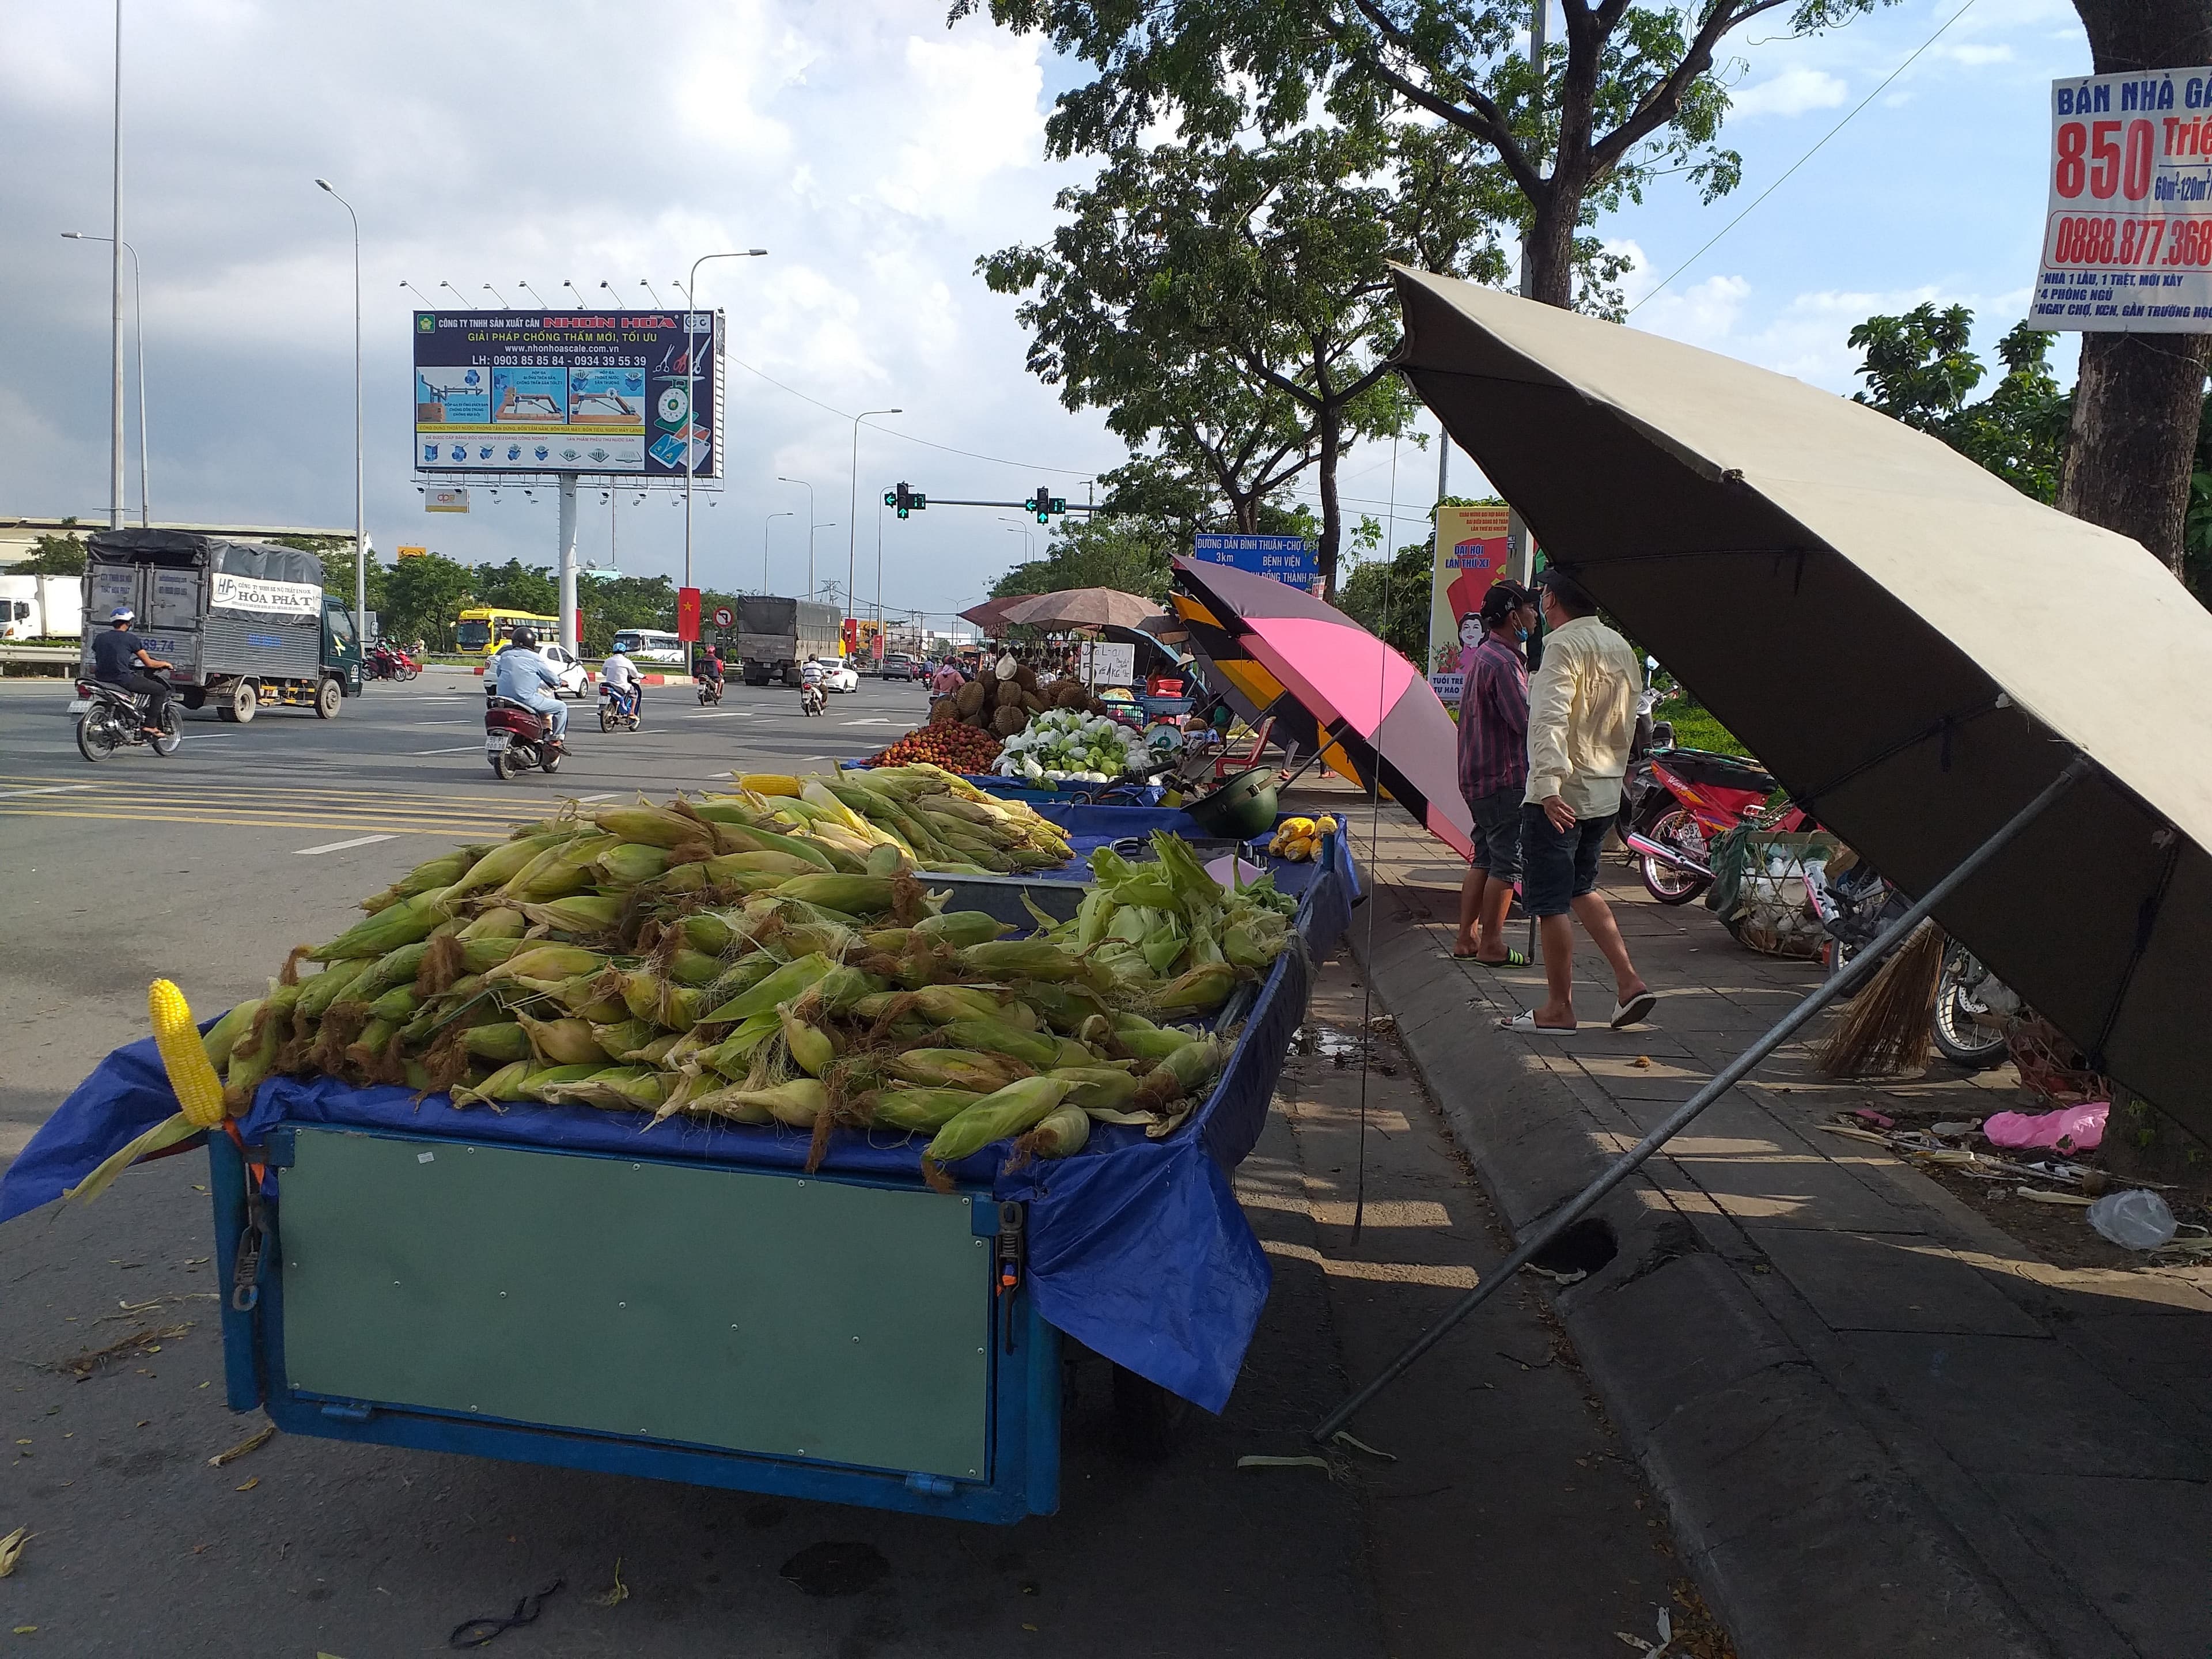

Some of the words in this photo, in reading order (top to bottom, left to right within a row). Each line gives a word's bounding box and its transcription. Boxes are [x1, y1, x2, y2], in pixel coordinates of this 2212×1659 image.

[2058, 79, 2110, 115] BÁN
[2122, 73, 2174, 111] NHÀ
[2056, 118, 2155, 200] 850
[2055, 217, 2212, 266] 0888.877.368
[2069, 273, 2074, 285] 1
[2102, 274, 2107, 285] 1
[2040, 289, 2048, 299] 4
[2050, 287, 2088, 301] PHÒNG
[2090, 287, 2113, 301] NGỦ
[438, 318, 458, 328] CÔNG
[459, 319, 468, 328] TY
[469, 319, 488, 328] TNHH
[490, 317, 504, 328] SẢN
[506, 316, 523, 328] XUẤT
[525, 317, 540, 328] CÂN
[544, 316, 615, 328] NHƠN
[468, 330, 488, 341] GIẢI
[492, 331, 520, 341] PHÁP
[523, 330, 560, 342] CHỐNG
[564, 330, 593, 342] THẤM
[597, 331, 619, 343] MỚI,
[622, 330, 639, 342] TỐI
[643, 332, 657, 342] ƯU
[505, 344, 619, 353] www.nhonhoascale.com.vn
[472, 355, 490, 365] LH:
[494, 355, 518, 365] 0903
[521, 355, 533, 365] 85
[536, 355, 549, 365] 85
[552, 355, 565, 365] 84
[574, 356, 599, 366] 0934
[602, 356, 615, 366] 39
[618, 356, 631, 366] 55
[634, 356, 646, 366] 39
[1054, 500, 1065, 512] 17
[1197, 538, 1222, 549] ĐƯỜNG
[1224, 536, 1238, 549] DẪN
[1240, 537, 1257, 550] BÌNH
[1455, 546, 1468, 555] ĐẠI
[1470, 544, 1484, 556] HỘI
[1216, 552, 1233, 563] 3km
[1263, 555, 1282, 567] BỆNH
[1284, 555, 1301, 567] VIỆN
[1445, 556, 1460, 569] LẦN
[1283, 570, 1307, 583] THÀNH
[238, 590, 268, 604] HÒA
[271, 594, 313, 606] PHÁT
[1668, 775, 1688, 791] Wave
